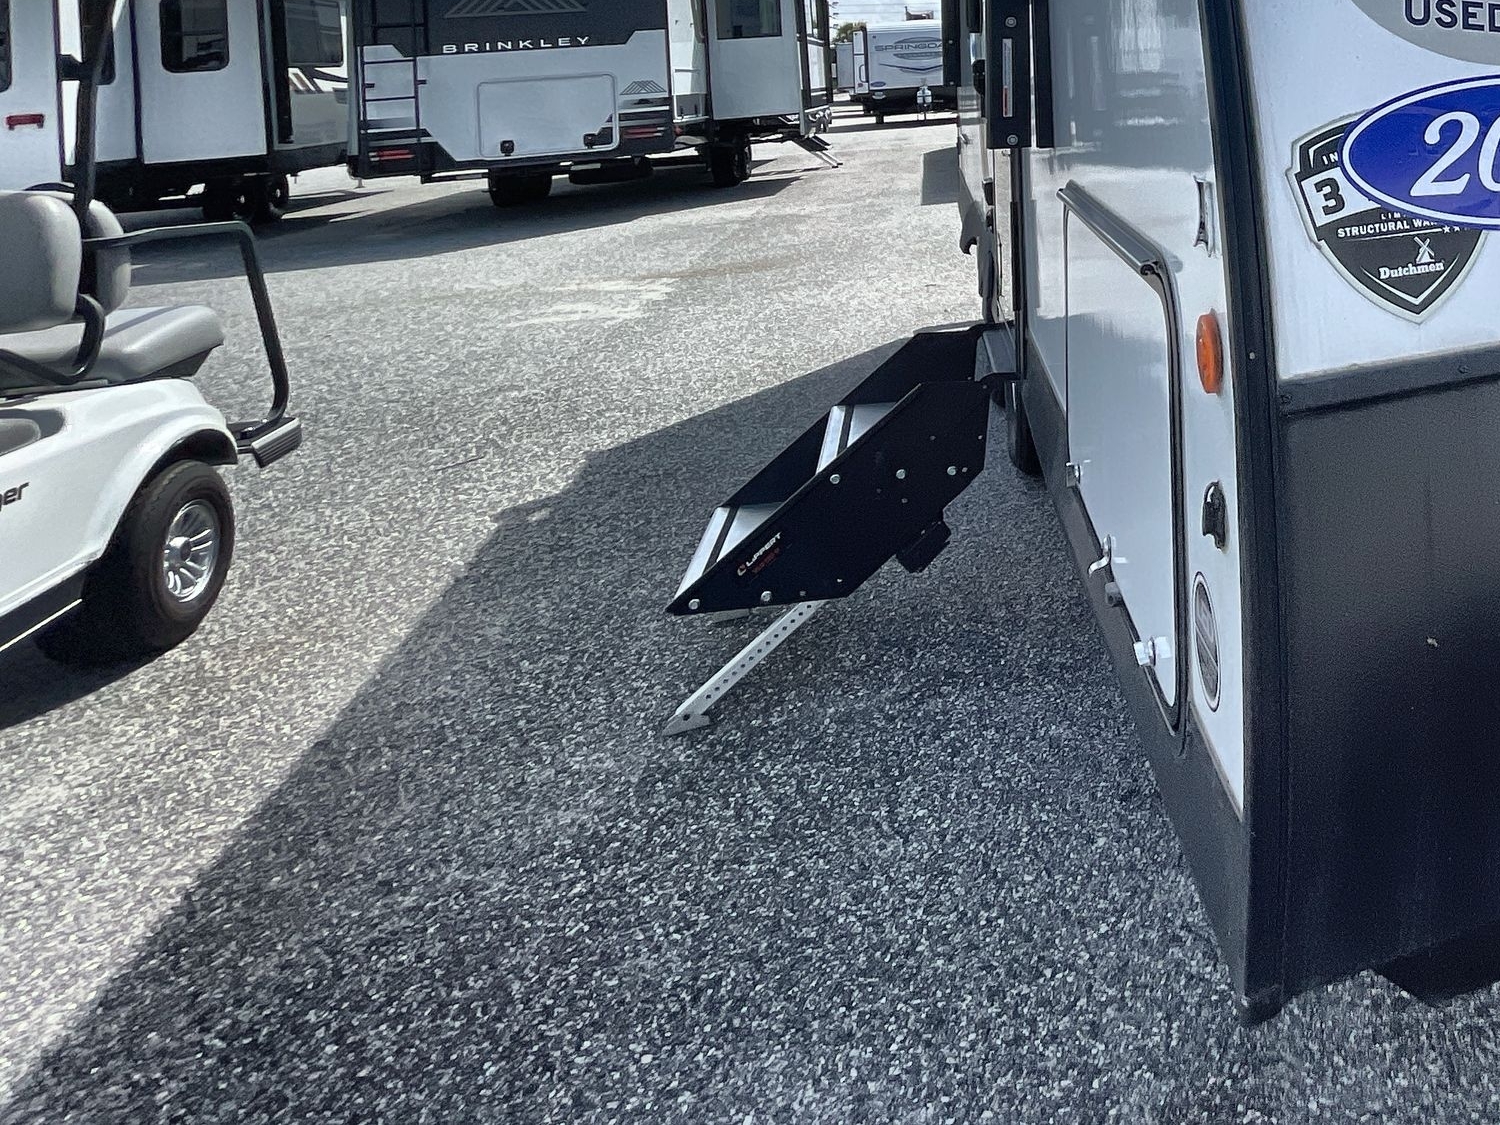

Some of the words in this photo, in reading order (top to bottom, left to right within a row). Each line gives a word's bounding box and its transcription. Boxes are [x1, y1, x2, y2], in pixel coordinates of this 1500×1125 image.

[442, 36, 590, 54] BRINKLEY
[1314, 177, 1346, 216] 3
[1381, 211, 1407, 220] LIM
[1337, 220, 1410, 238] STRUCTURAL
[1379, 261, 1444, 279] Dutchmen
[0, 481, 30, 512] er
